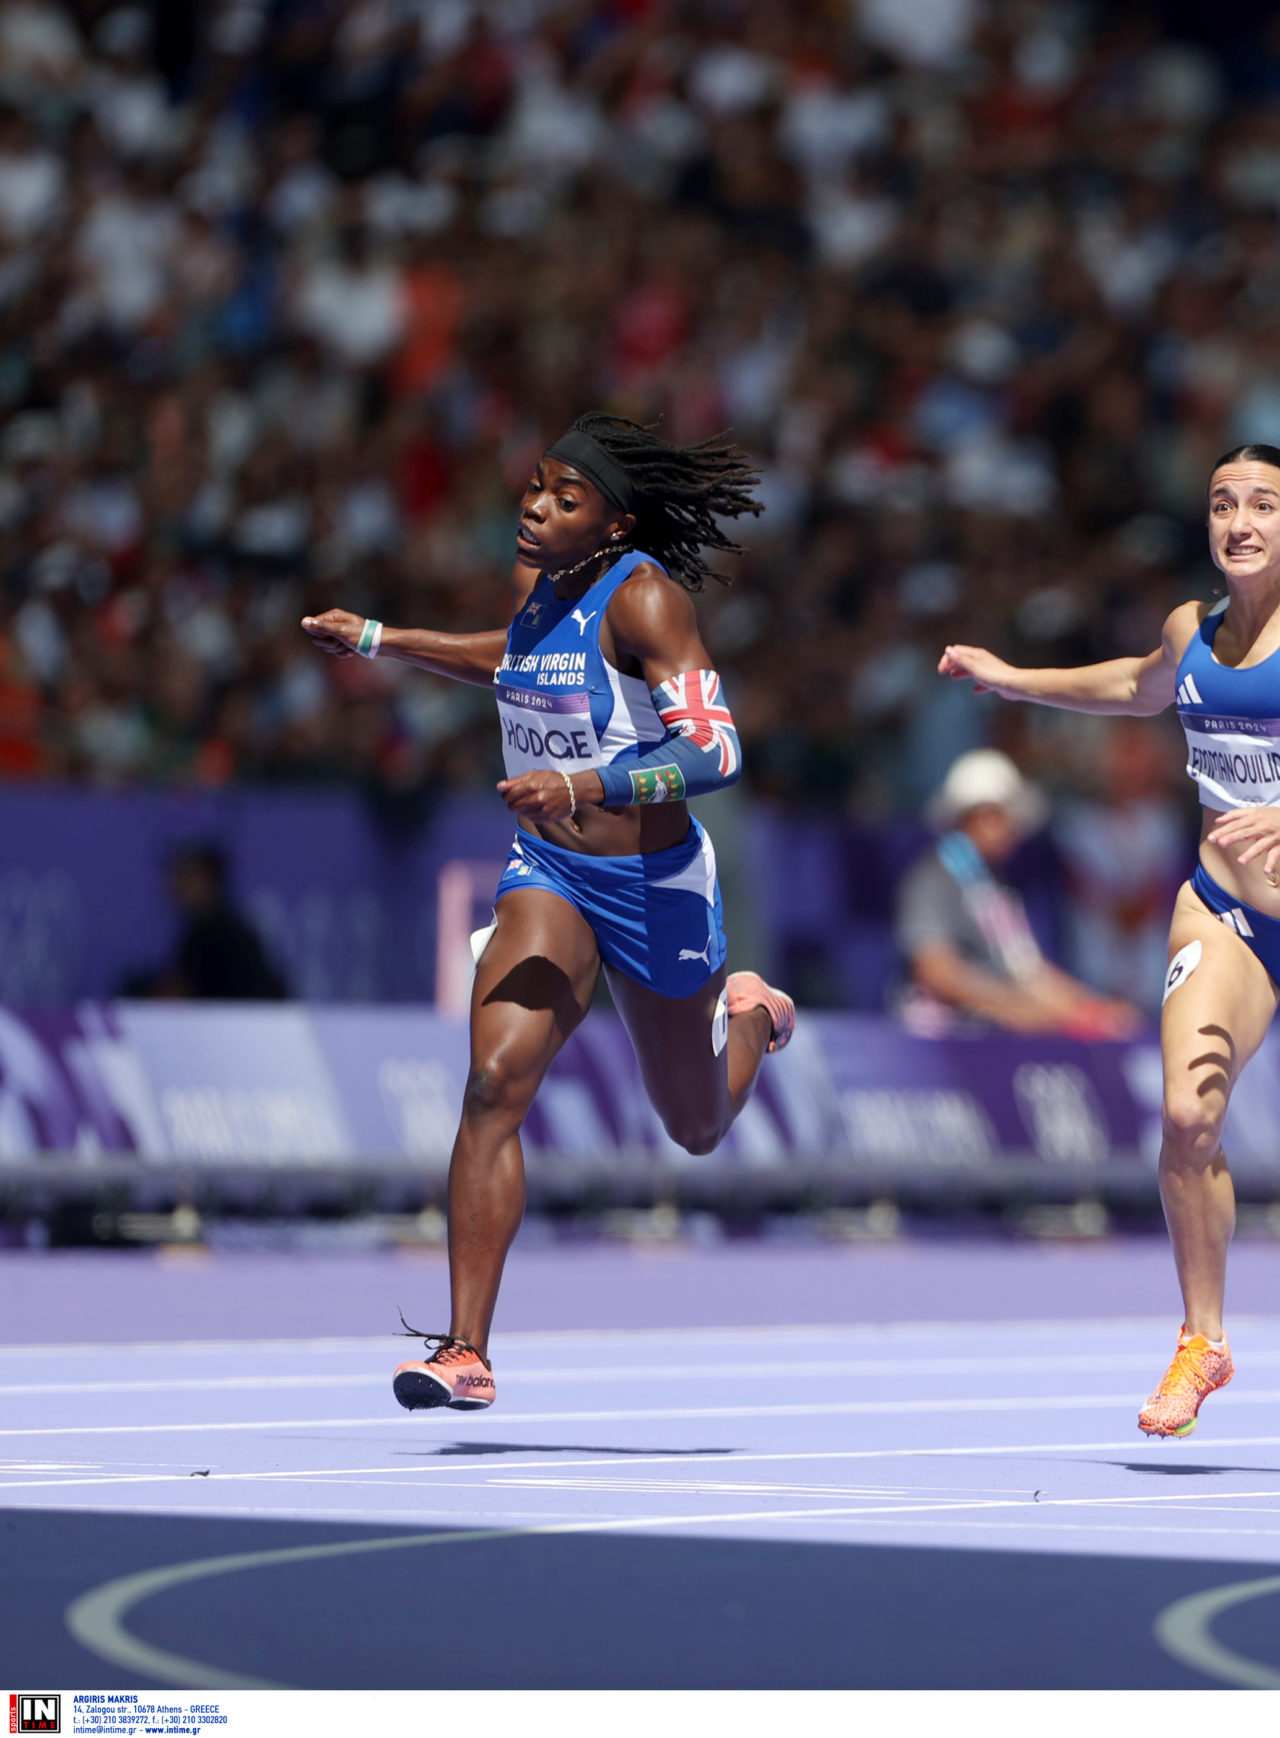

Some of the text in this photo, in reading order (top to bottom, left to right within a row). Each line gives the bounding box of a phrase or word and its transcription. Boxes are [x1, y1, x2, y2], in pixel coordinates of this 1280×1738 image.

[501, 652, 587, 672] BRITISH VIRGIN
[536, 672, 585, 685] ISLANDS
[506, 690, 553, 709] PARIS 2024
[1204, 719, 1267, 732] PARIS 2024
[502, 717, 592, 760] HODGE
